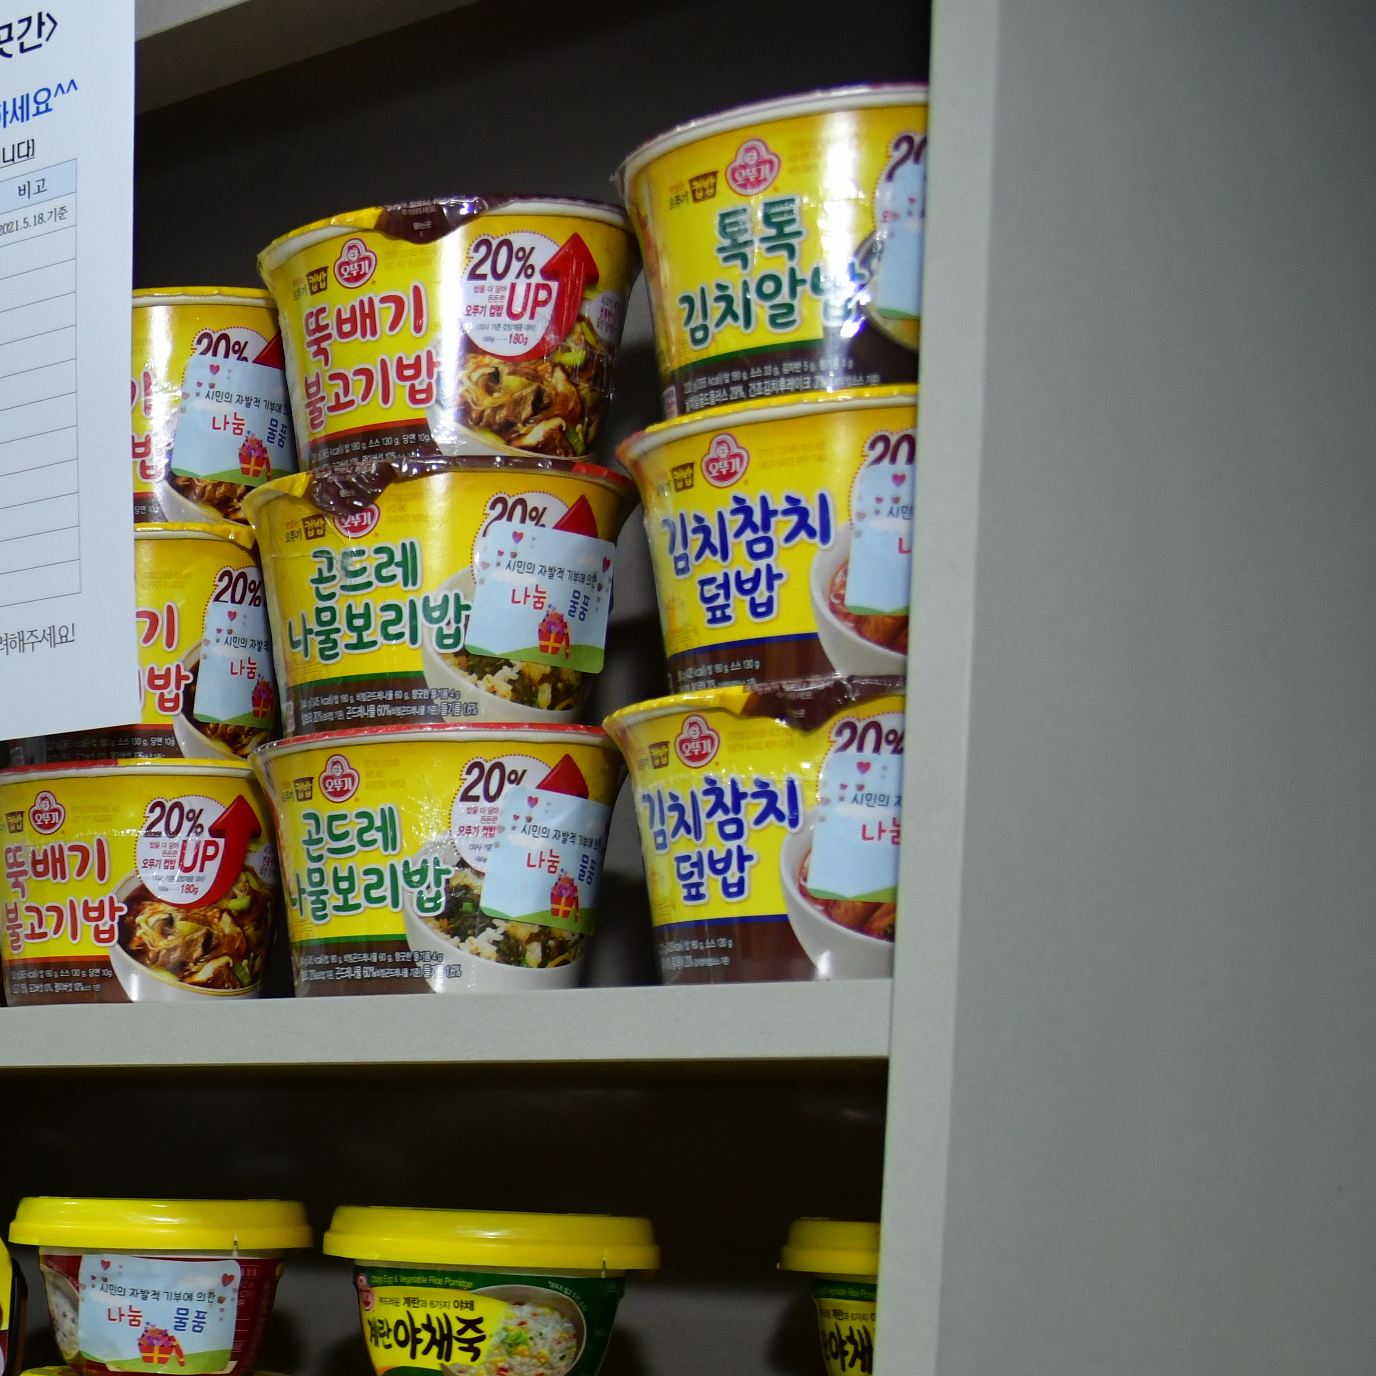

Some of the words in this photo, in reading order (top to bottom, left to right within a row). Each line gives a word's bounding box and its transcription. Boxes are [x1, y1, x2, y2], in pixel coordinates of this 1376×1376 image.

[18, 179, 48, 200] 비고
[715, 196, 804, 272] 톡톡
[308, 268, 328, 291] 컵밥
[466, 239, 536, 282] 20%
[505, 280, 553, 321] UP
[678, 262, 869, 349] 김치알밥
[303, 281, 426, 368] 뚝배기
[204, 388, 234, 405] 시민의
[234, 393, 262, 410] 자발적
[262, 396, 284, 413] 기부에
[301, 346, 444, 436] 불고기밥
[211, 412, 246, 437] 나눔
[266, 416, 290, 448] 물품
[661, 492, 835, 578] 김치참치
[309, 538, 423, 604] 곤드레
[698, 562, 785, 627] 덮밥
[287, 592, 474, 664] 나물보리밥
[510, 586, 546, 609] 나눔
[568, 588, 592, 622] 물품
[223, 636, 248, 649] 시민의
[249, 639, 270, 655] 자발적
[229, 658, 258, 681] 나눔
[641, 774, 803, 851] 김치참치
[850, 791, 890, 808] 시민의
[147, 799, 205, 838] 20%
[180, 838, 220, 874] UP
[300, 805, 401, 862] 곤드레
[3, 838, 107, 900] 뚝배기
[290, 855, 452, 925] 나물보리밥
[526, 850, 560, 873] 나눔
[577, 854, 595, 887] 물품
[674, 844, 755, 903] 덮밥
[4, 895, 127, 956] 불고기밥
[99, 1284, 126, 1298] 시민의
[128, 1287, 161, 1302] 자발적
[163, 1289, 194, 1303] 기부에
[196, 1290, 217, 1305] 의한
[106, 1304, 144, 1328] 나눔
[172, 1306, 209, 1334] 물품
